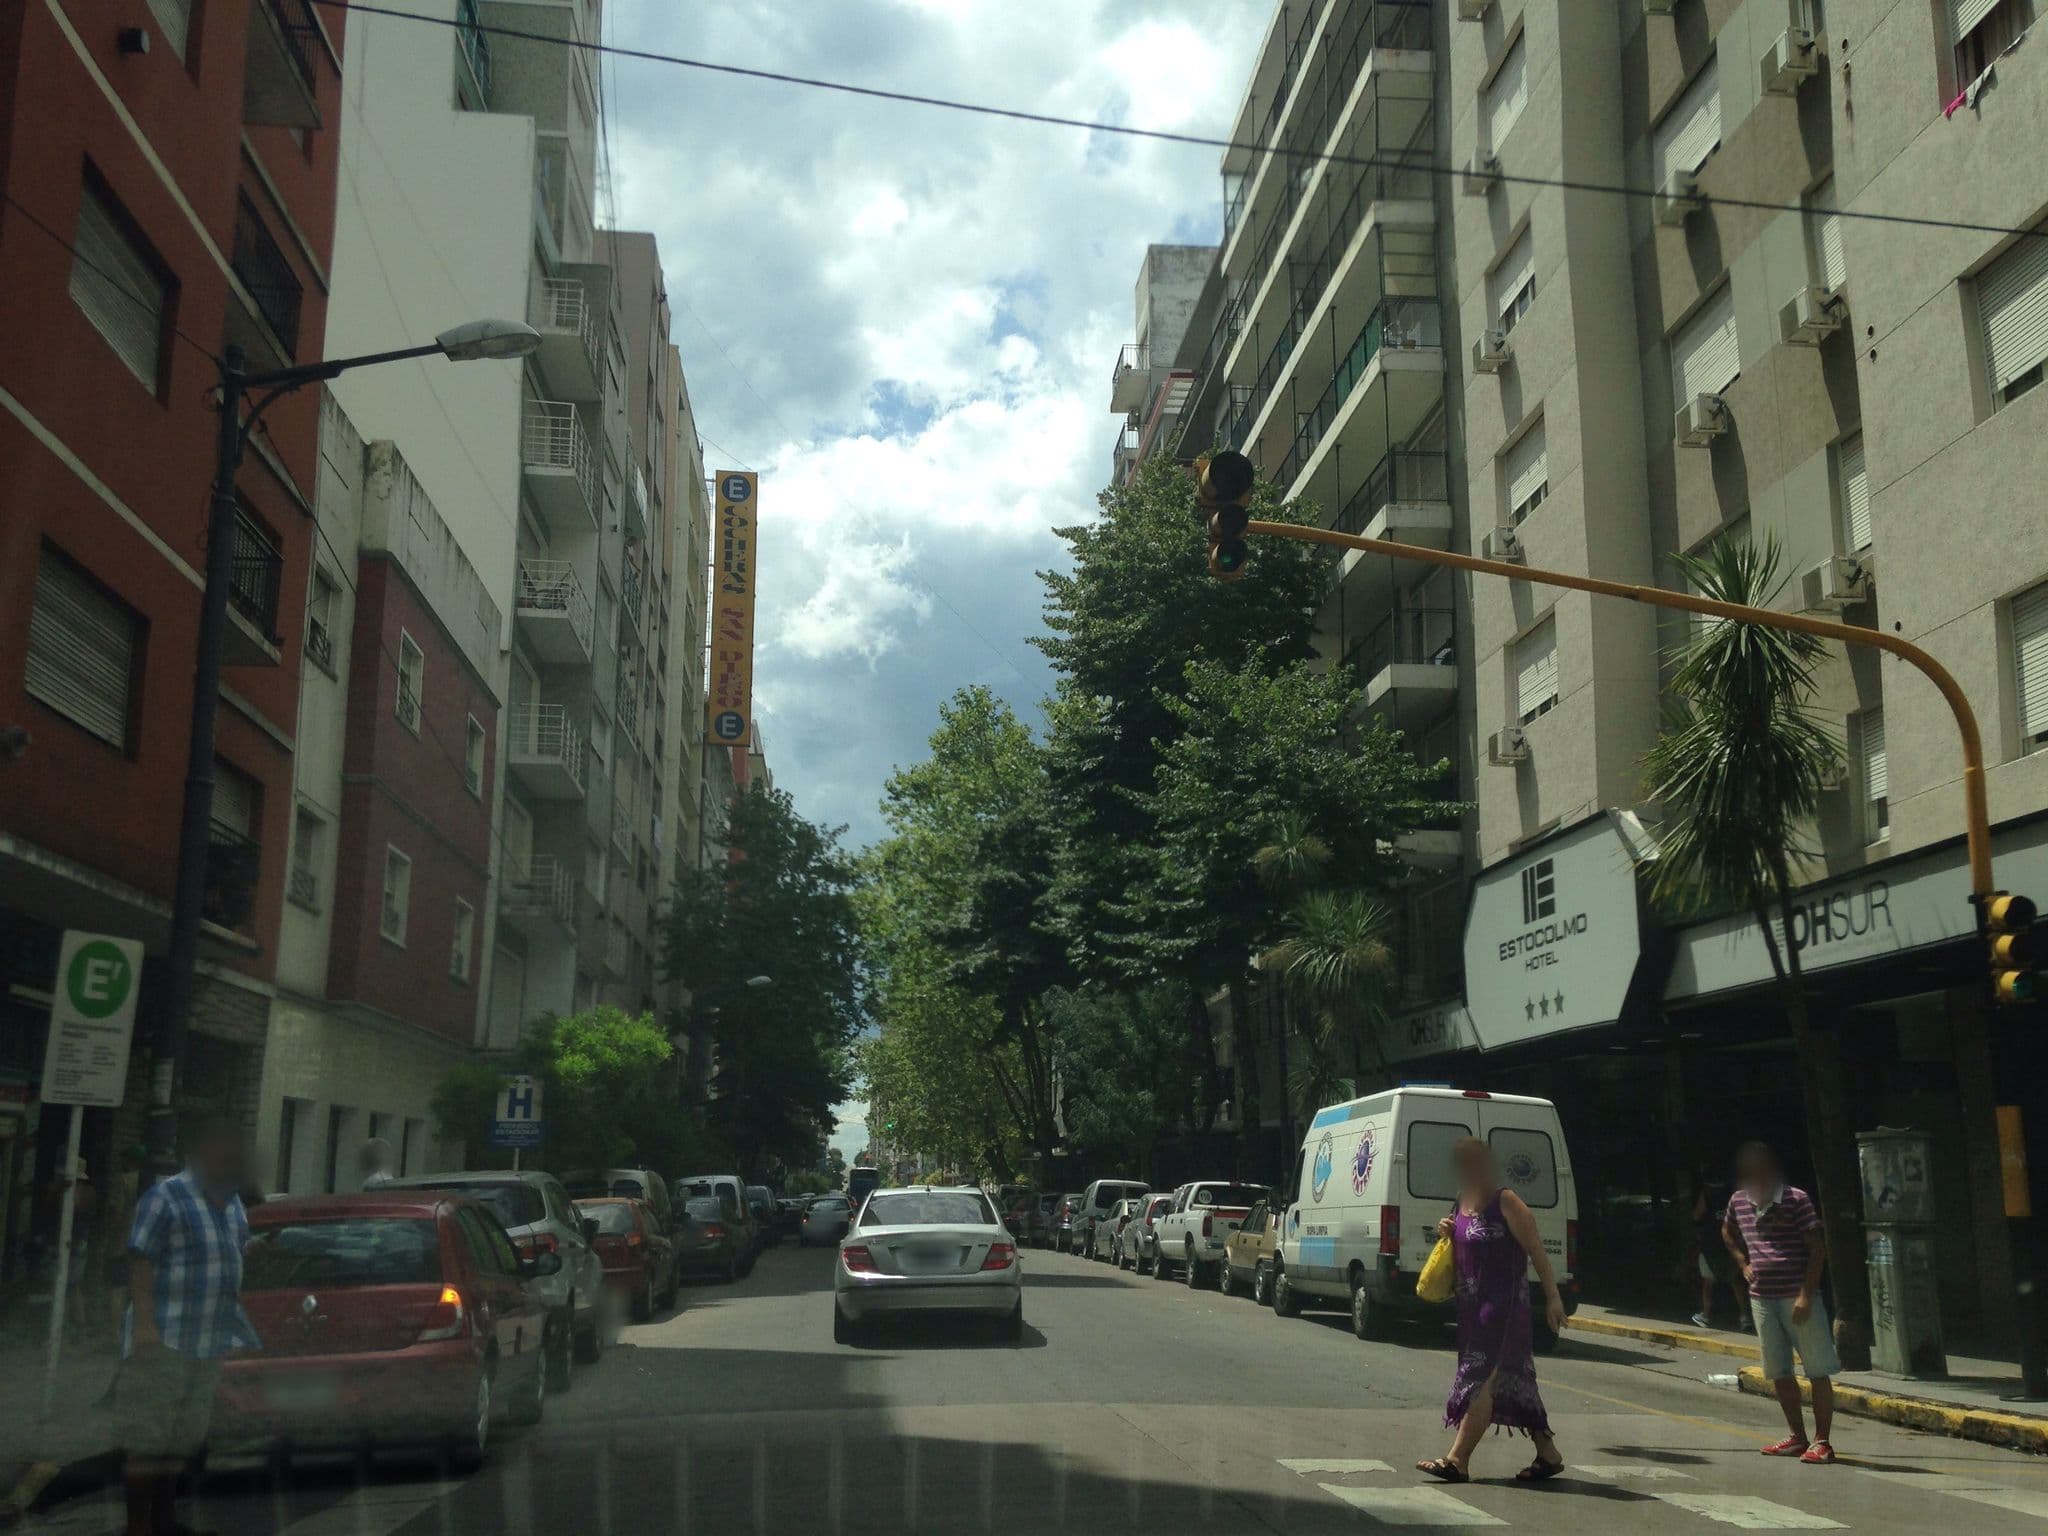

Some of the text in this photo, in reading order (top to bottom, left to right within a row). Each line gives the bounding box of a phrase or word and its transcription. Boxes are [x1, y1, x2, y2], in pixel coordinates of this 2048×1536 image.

[729, 478, 744, 499] E
[722, 716, 737, 737] E
[1499, 913, 1588, 961] ESTOCOLMO
[1525, 951, 1559, 971] HOTEL
[507, 1087, 533, 1119] H
